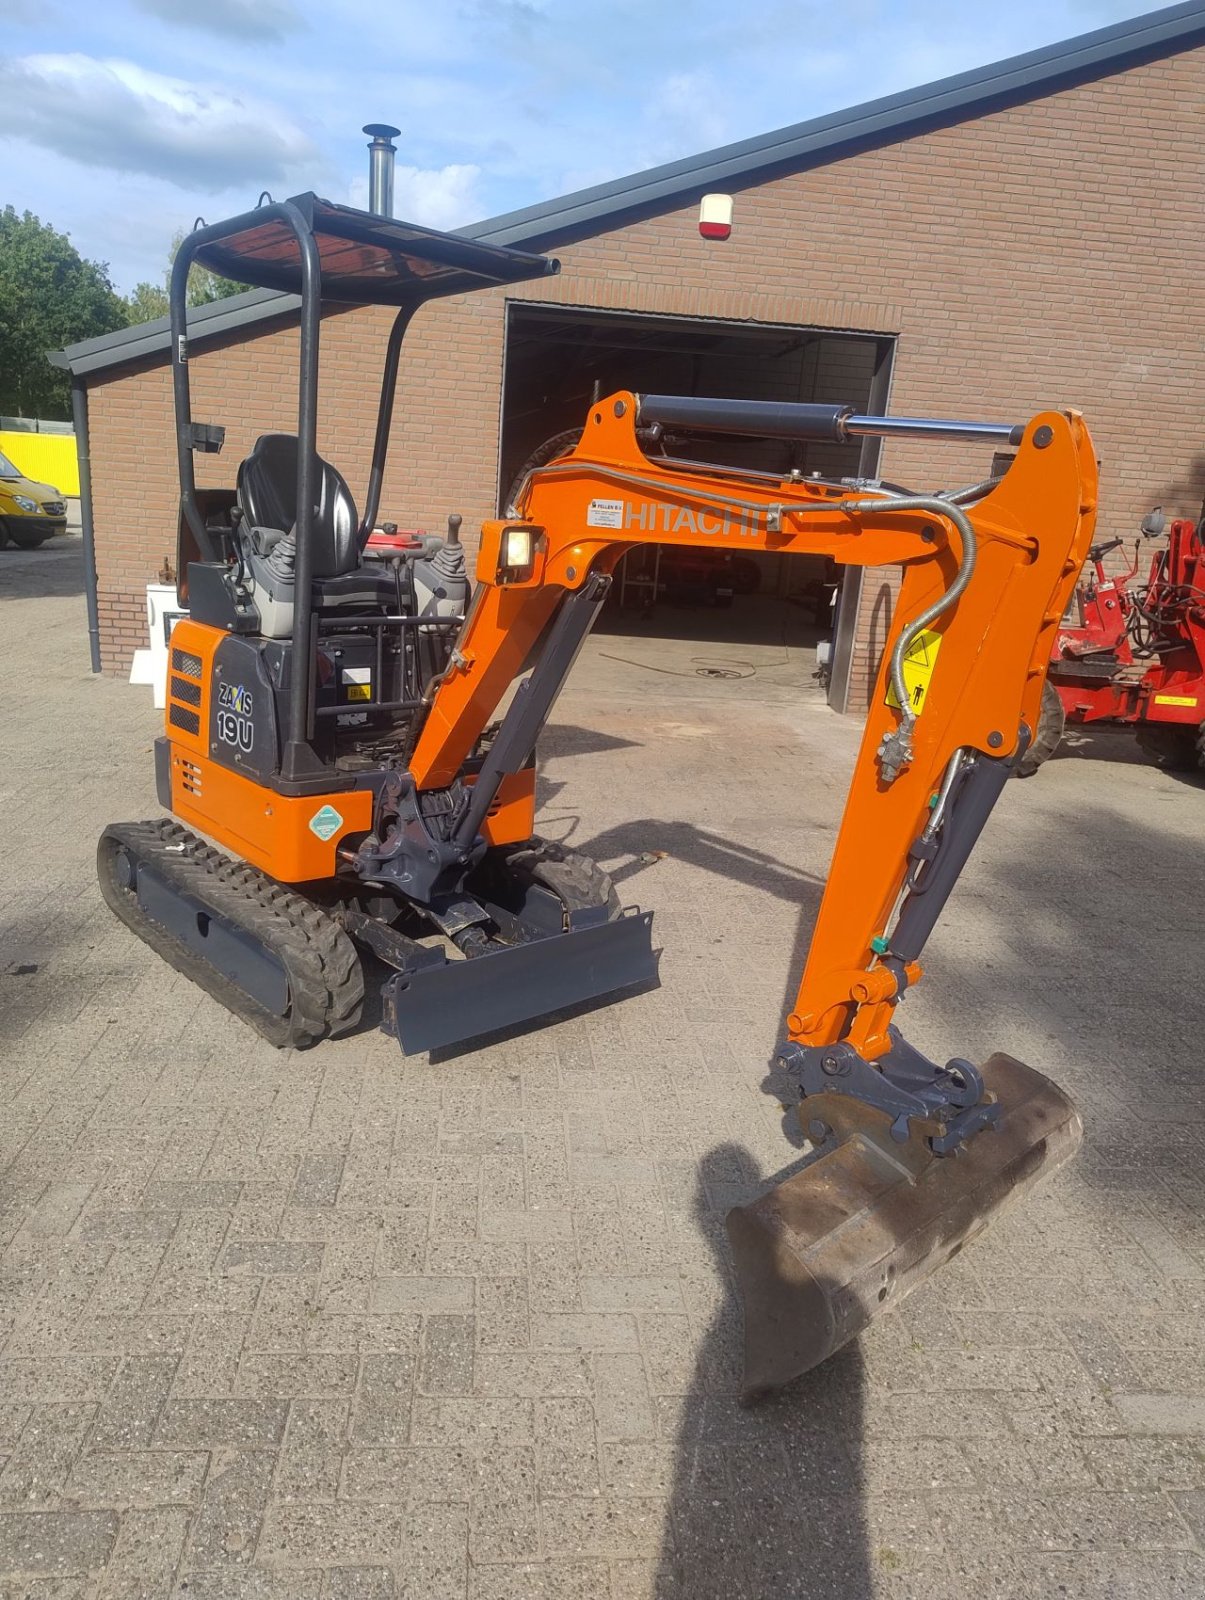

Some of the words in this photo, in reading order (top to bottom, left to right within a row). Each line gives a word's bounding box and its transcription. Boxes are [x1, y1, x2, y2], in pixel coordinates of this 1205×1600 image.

[625, 502, 760, 536] HITACHI
[219, 682, 253, 717] ZAXIS
[217, 711, 254, 753] 19U
